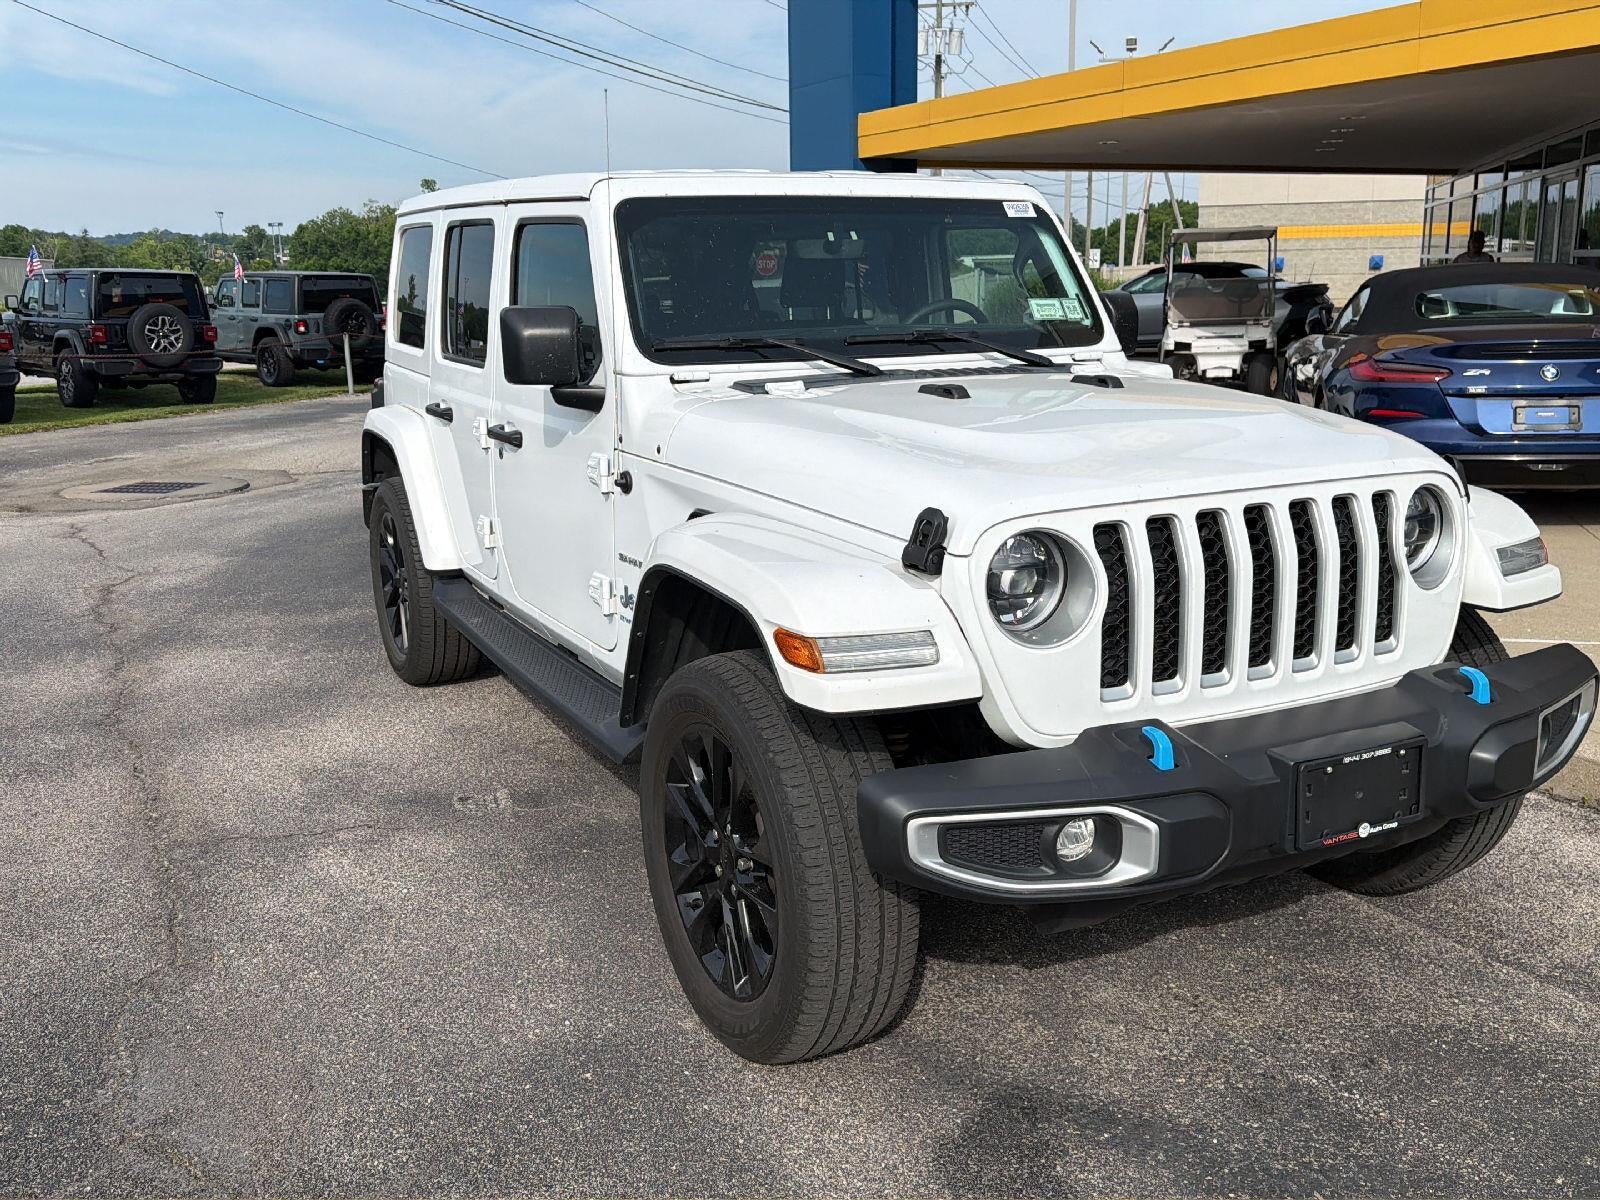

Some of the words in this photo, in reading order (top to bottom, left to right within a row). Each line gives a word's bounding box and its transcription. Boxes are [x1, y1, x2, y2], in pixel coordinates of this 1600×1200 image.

[758, 260, 776, 269] STOP
[1462, 368, 1491, 376] Z4
[1370, 826, 1382, 834] Auto
[1383, 821, 1398, 830] Group
